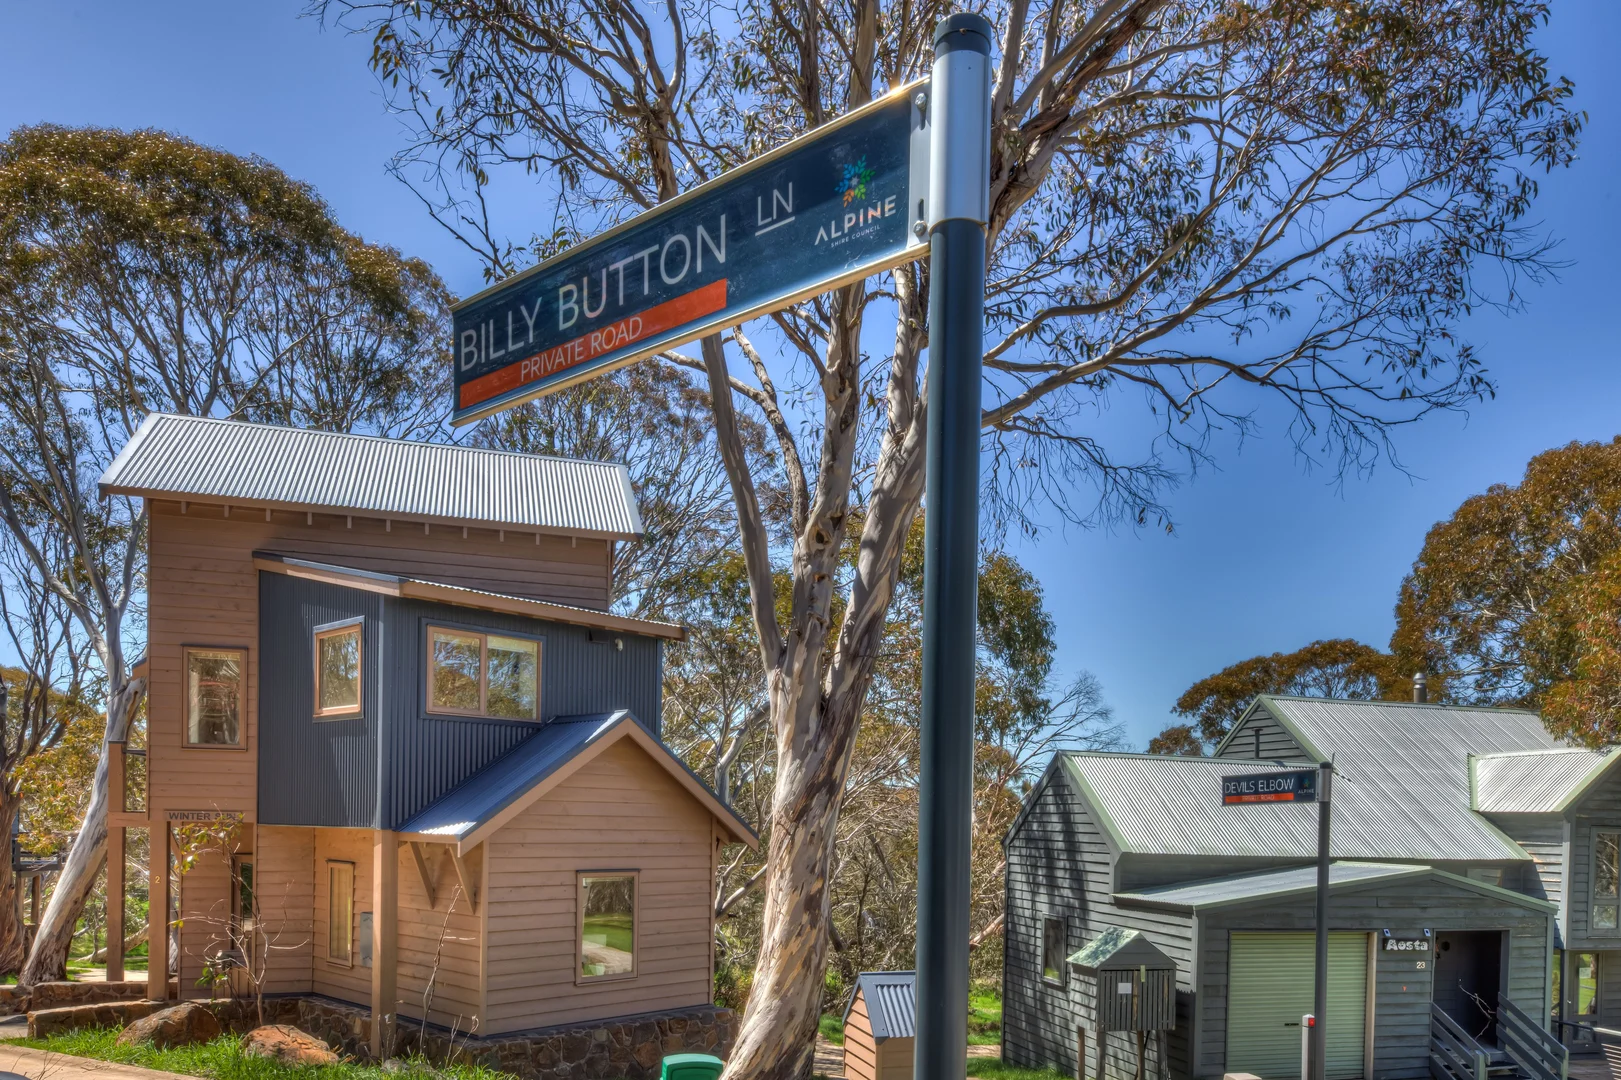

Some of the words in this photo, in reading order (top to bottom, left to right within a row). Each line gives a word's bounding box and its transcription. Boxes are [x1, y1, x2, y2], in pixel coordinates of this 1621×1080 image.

[814, 194, 897, 246] ALPINE
[830, 236, 850, 248] SHIRE
[851, 224, 880, 240] COUNCIL
[460, 297, 542, 372] BILLY
[558, 214, 727, 330] BUTTON
[757, 181, 793, 227] LN
[520, 338, 585, 383] PRIVATE
[590, 316, 643, 352] ROAD
[1224, 780, 1255, 793] DEVILS
[1258, 777, 1294, 792] ELBOW
[168, 811, 211, 821] WINTER
[155, 875, 161, 884] 2
[1386, 939, 1429, 951] Aosta
[1416, 961, 1426, 969] 23
